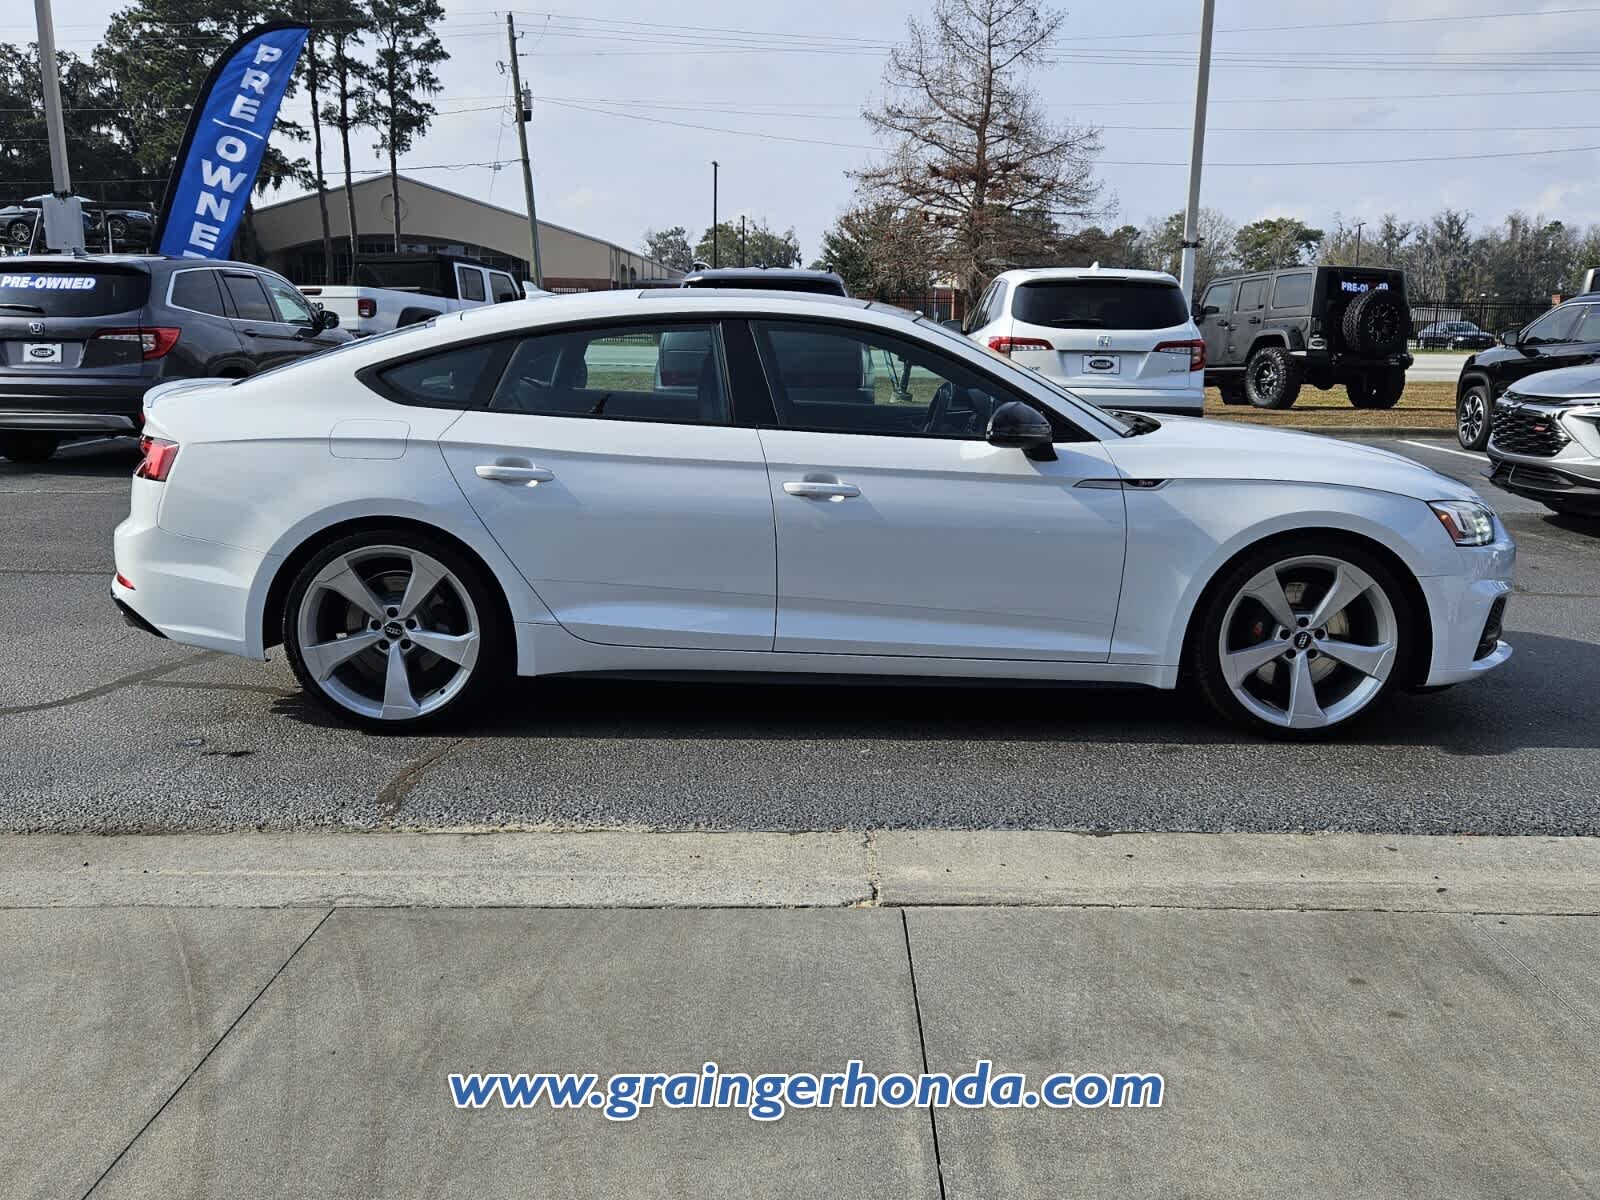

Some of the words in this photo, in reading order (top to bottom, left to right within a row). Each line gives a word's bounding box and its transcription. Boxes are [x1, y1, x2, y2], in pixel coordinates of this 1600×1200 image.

[228, 43, 283, 122] PRE
[182, 135, 249, 258] OWNE
[1, 275, 96, 289] PRE-OWNED
